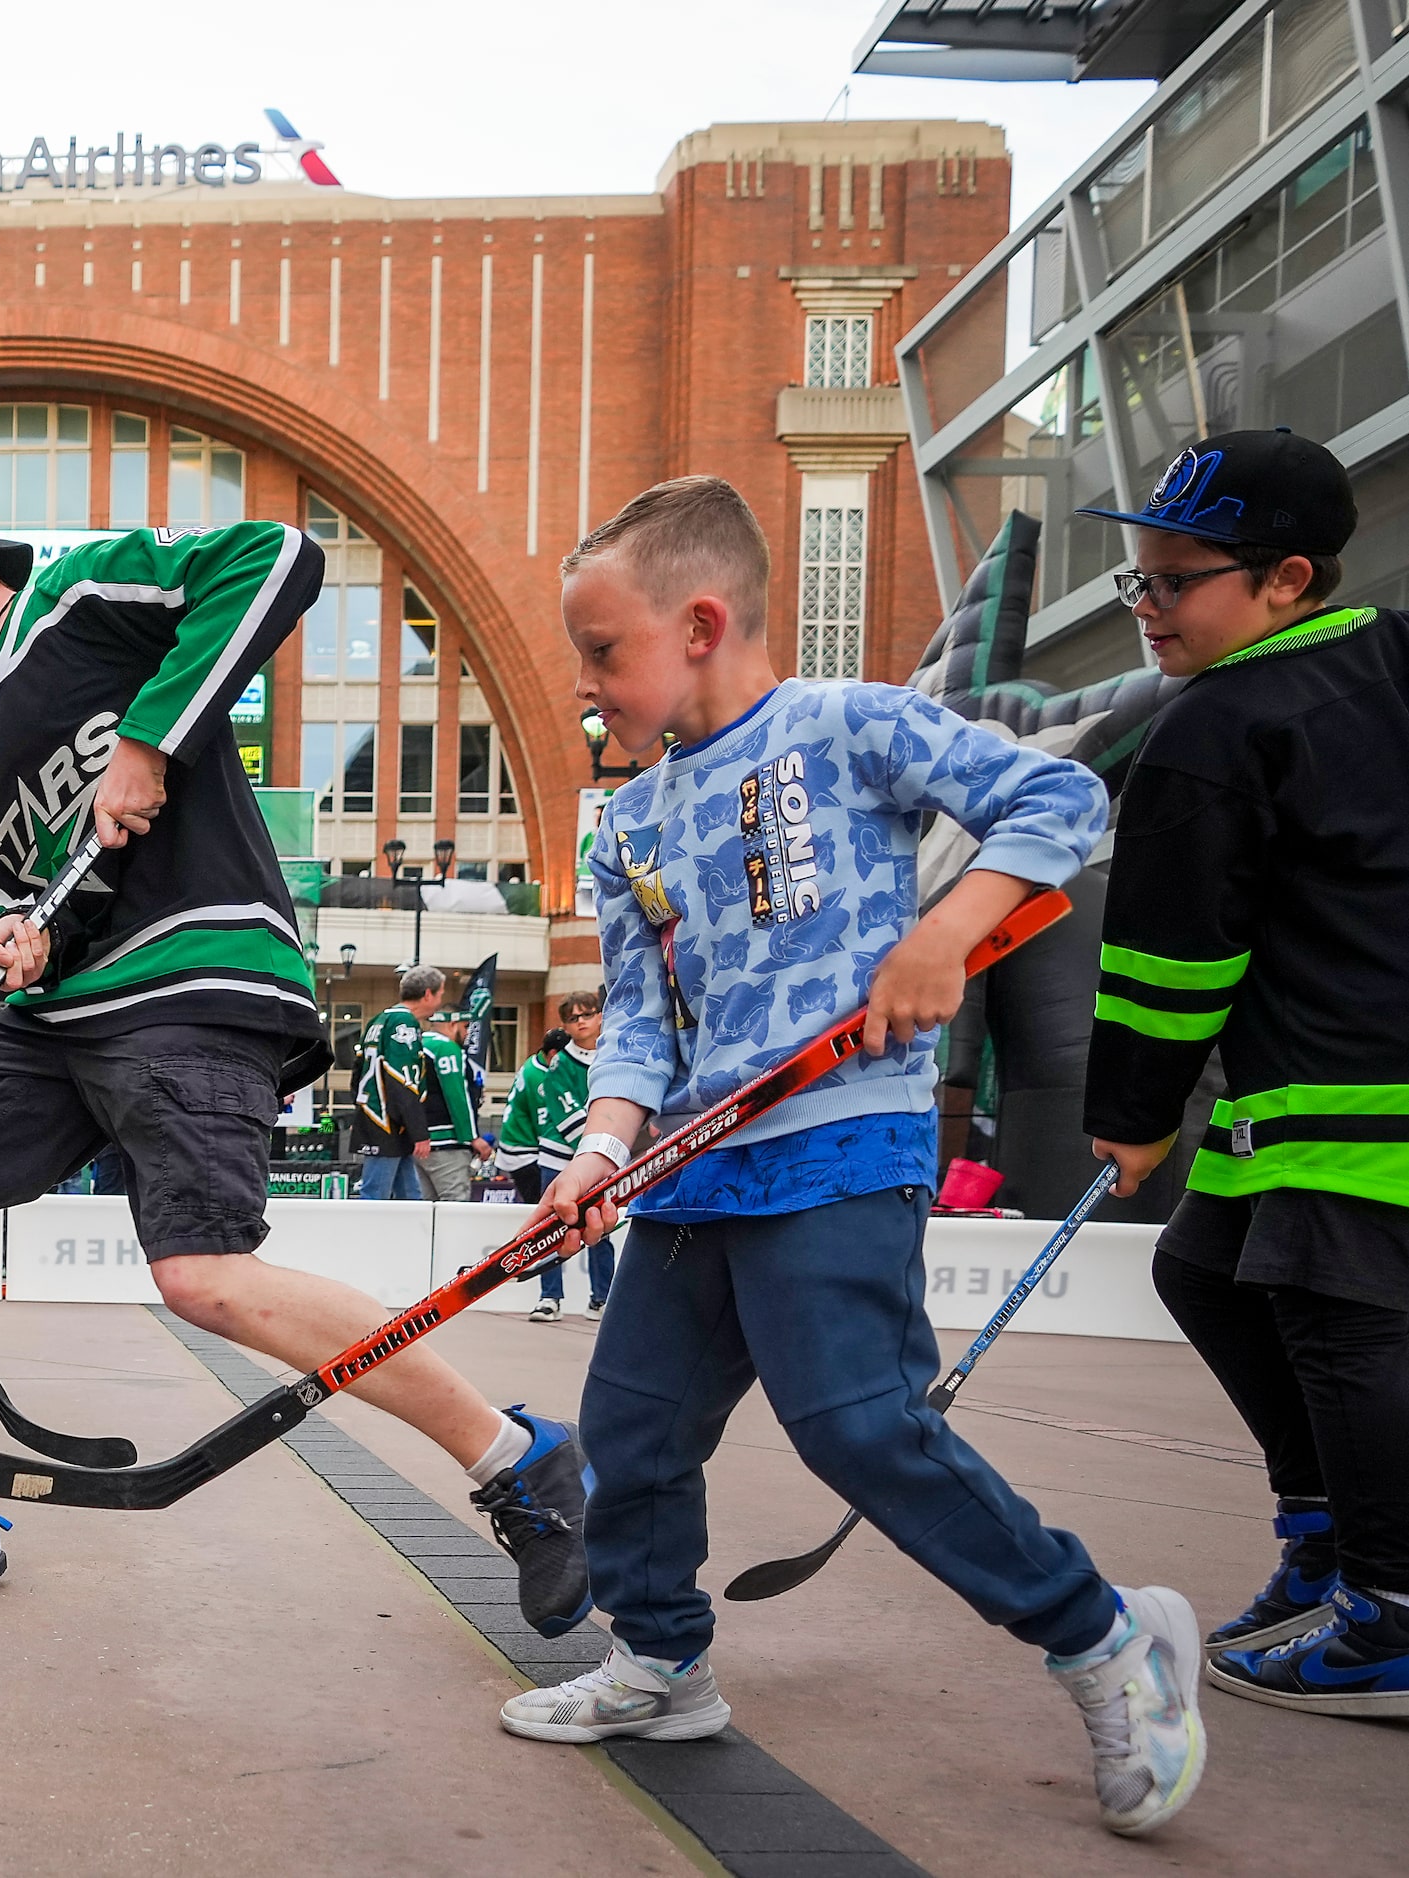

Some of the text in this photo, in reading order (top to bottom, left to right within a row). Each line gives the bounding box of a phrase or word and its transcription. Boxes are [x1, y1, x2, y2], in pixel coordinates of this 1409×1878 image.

[16, 132, 261, 188] Airlines
[761, 764, 788, 924] THE HEDGEHOG
[777, 751, 820, 918] SONIC
[748, 858, 772, 915] チーム
[438, 1054, 460, 1075] 91
[687, 1112, 738, 1151] 1020
[303, 1174, 321, 1182] CUP
[603, 1145, 679, 1202] POWER
[501, 1243, 530, 1273] SX
[529, 1225, 568, 1257] COMP
[330, 1305, 442, 1387] Franklin
